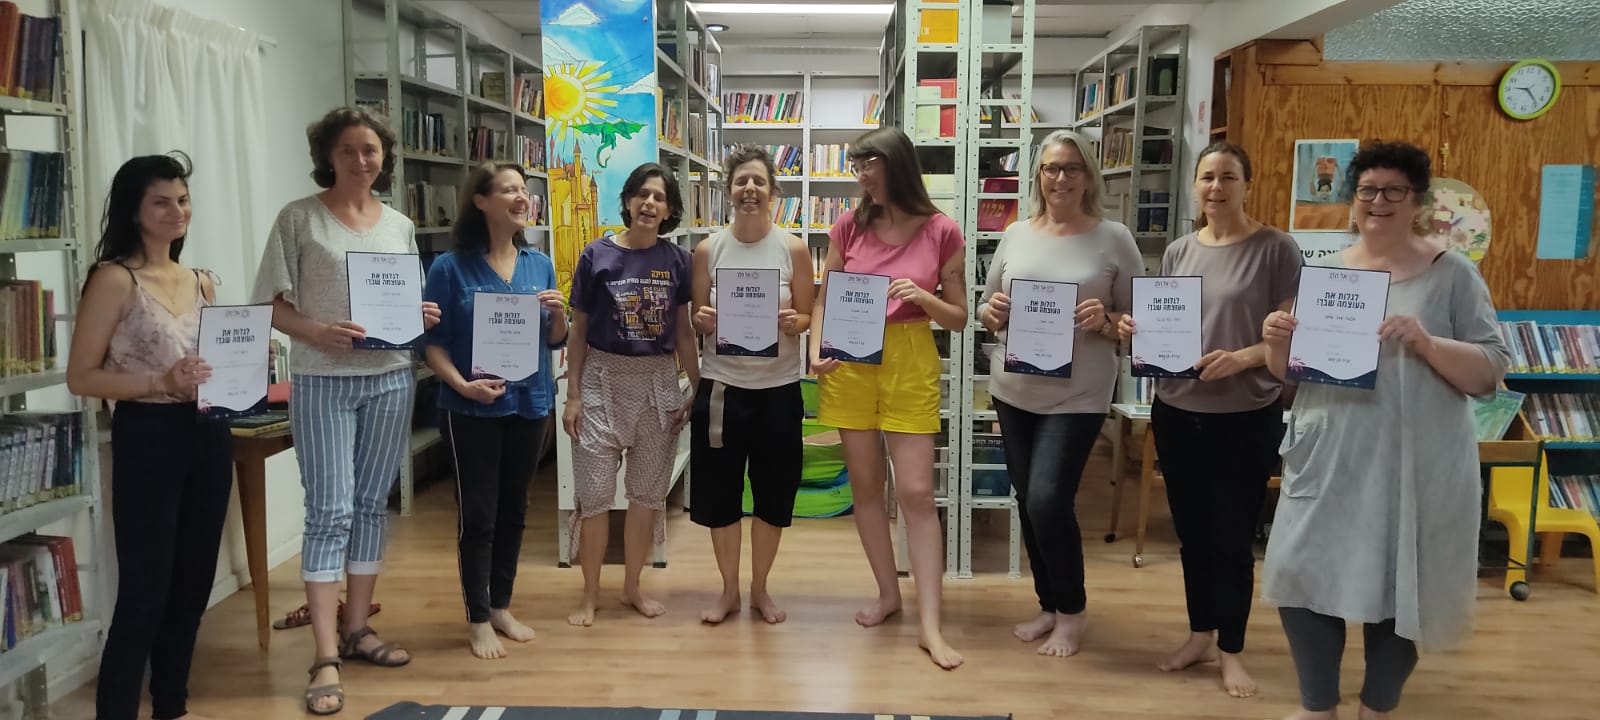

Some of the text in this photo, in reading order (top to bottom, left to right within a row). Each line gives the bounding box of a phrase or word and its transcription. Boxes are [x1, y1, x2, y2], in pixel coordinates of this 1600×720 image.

[1325, 291, 1359, 301] לגלות את
[1316, 298, 1365, 310] העוצמה שבך!
